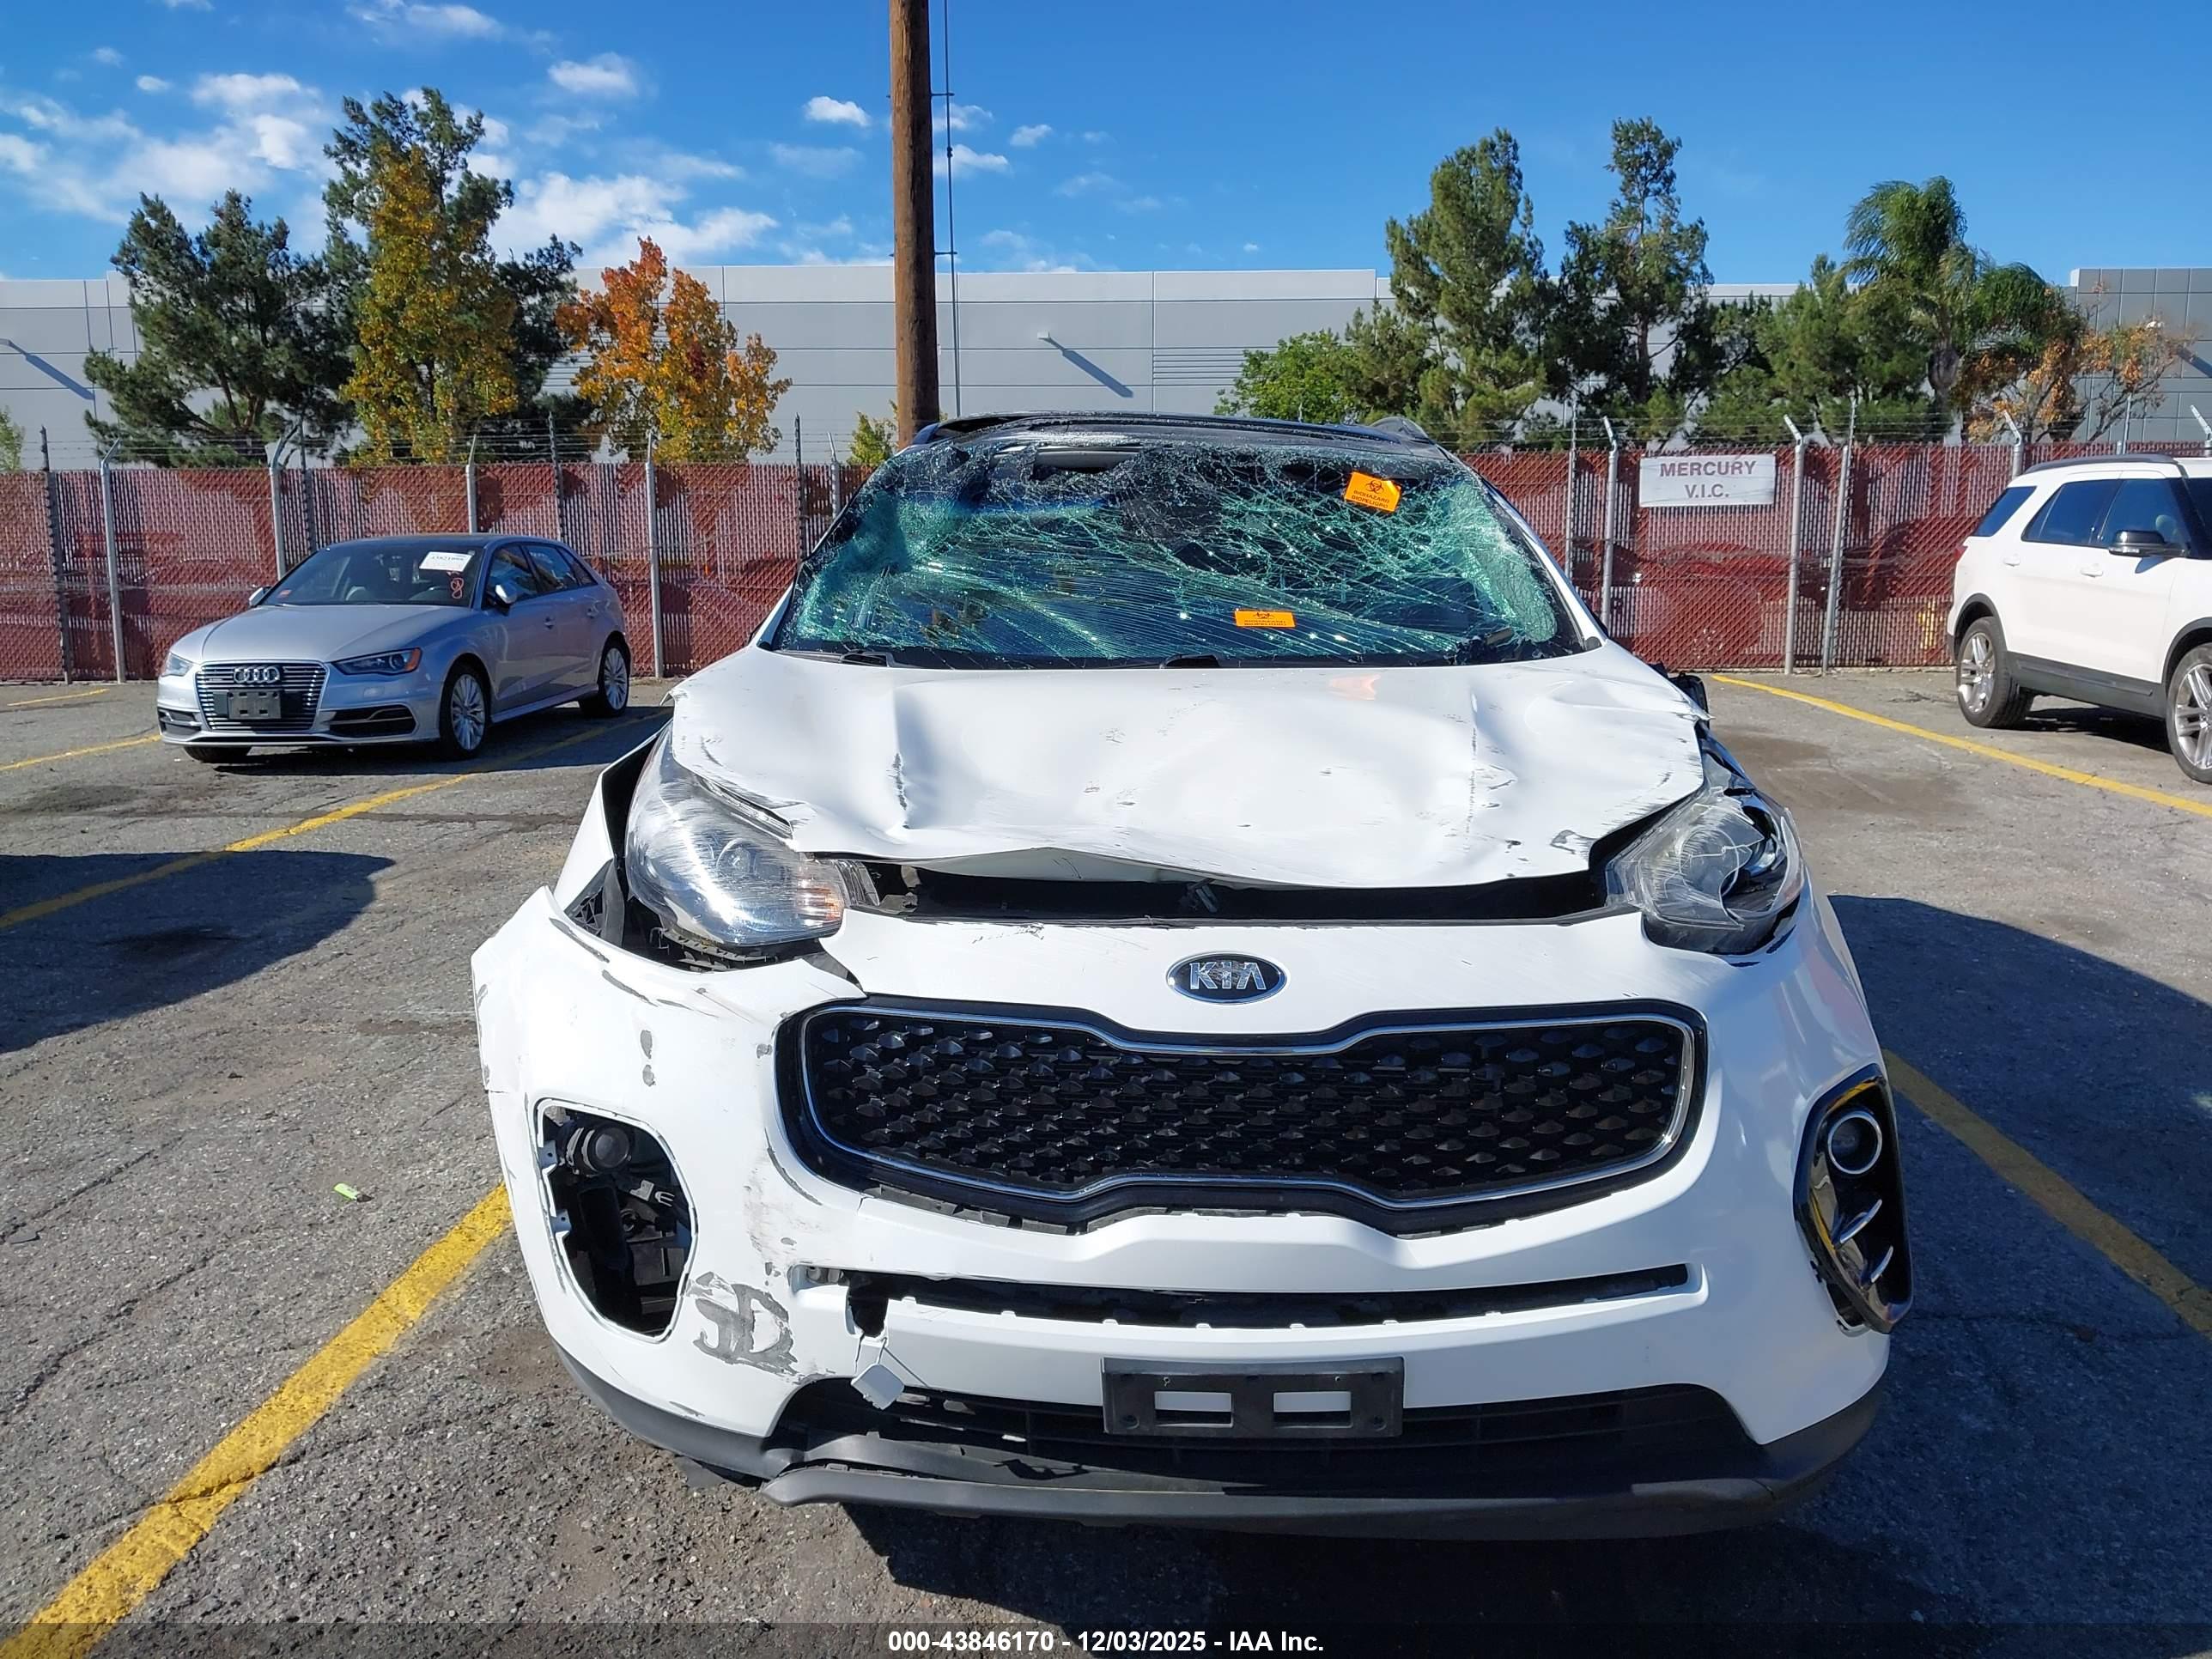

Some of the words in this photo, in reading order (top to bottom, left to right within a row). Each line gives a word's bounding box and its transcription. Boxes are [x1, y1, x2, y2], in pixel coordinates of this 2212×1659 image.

[1660, 460, 1756, 477] MERCURY
[1353, 489, 1389, 503] BIOHAZARD
[1684, 483, 1729, 498] V.I.C.
[1189, 961, 1267, 989] KIA
